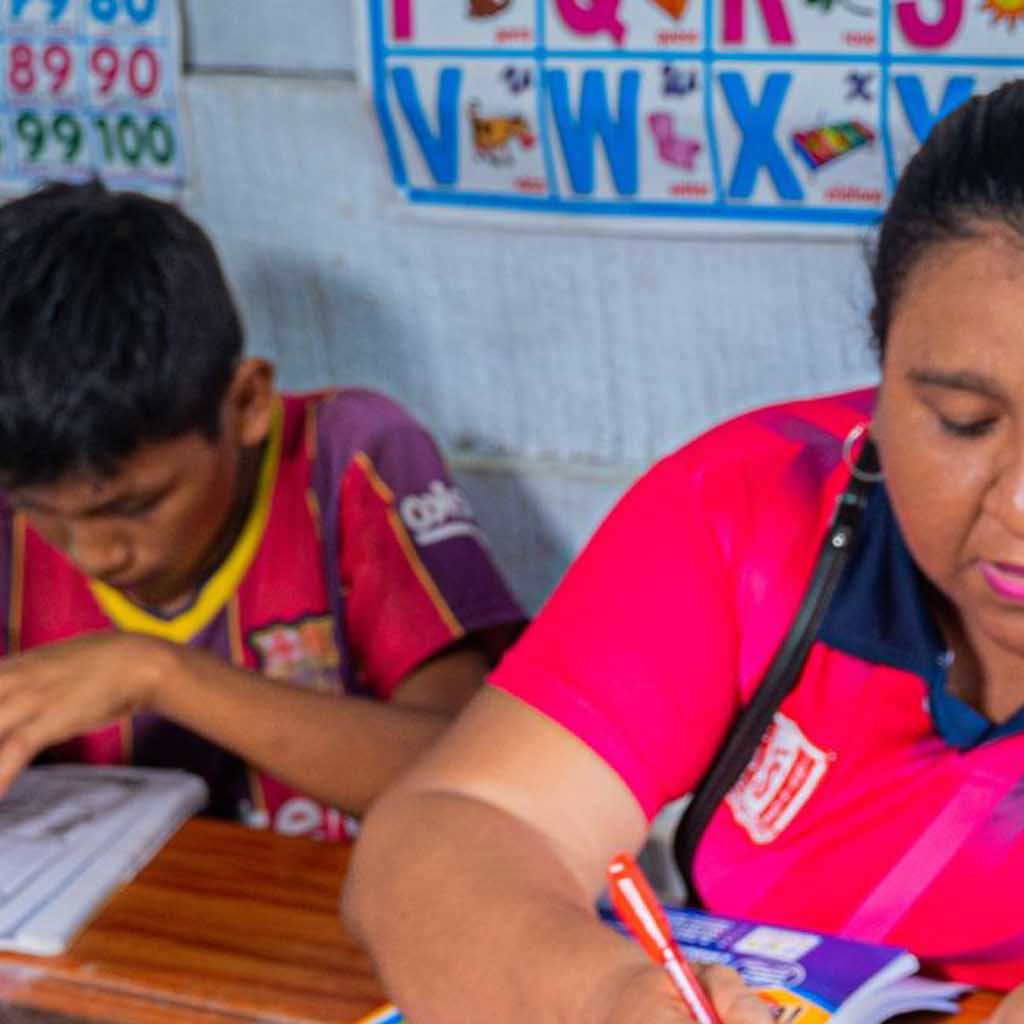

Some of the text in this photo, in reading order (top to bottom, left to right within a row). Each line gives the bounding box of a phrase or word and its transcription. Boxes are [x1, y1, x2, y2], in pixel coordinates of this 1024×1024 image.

[9, 42, 160, 98] 89 90
[847, 73, 873, 101] x
[16, 110, 175, 167] 99 100
[391, 66, 462, 185] V
[546, 69, 640, 195] W
[718, 73, 804, 198] X
